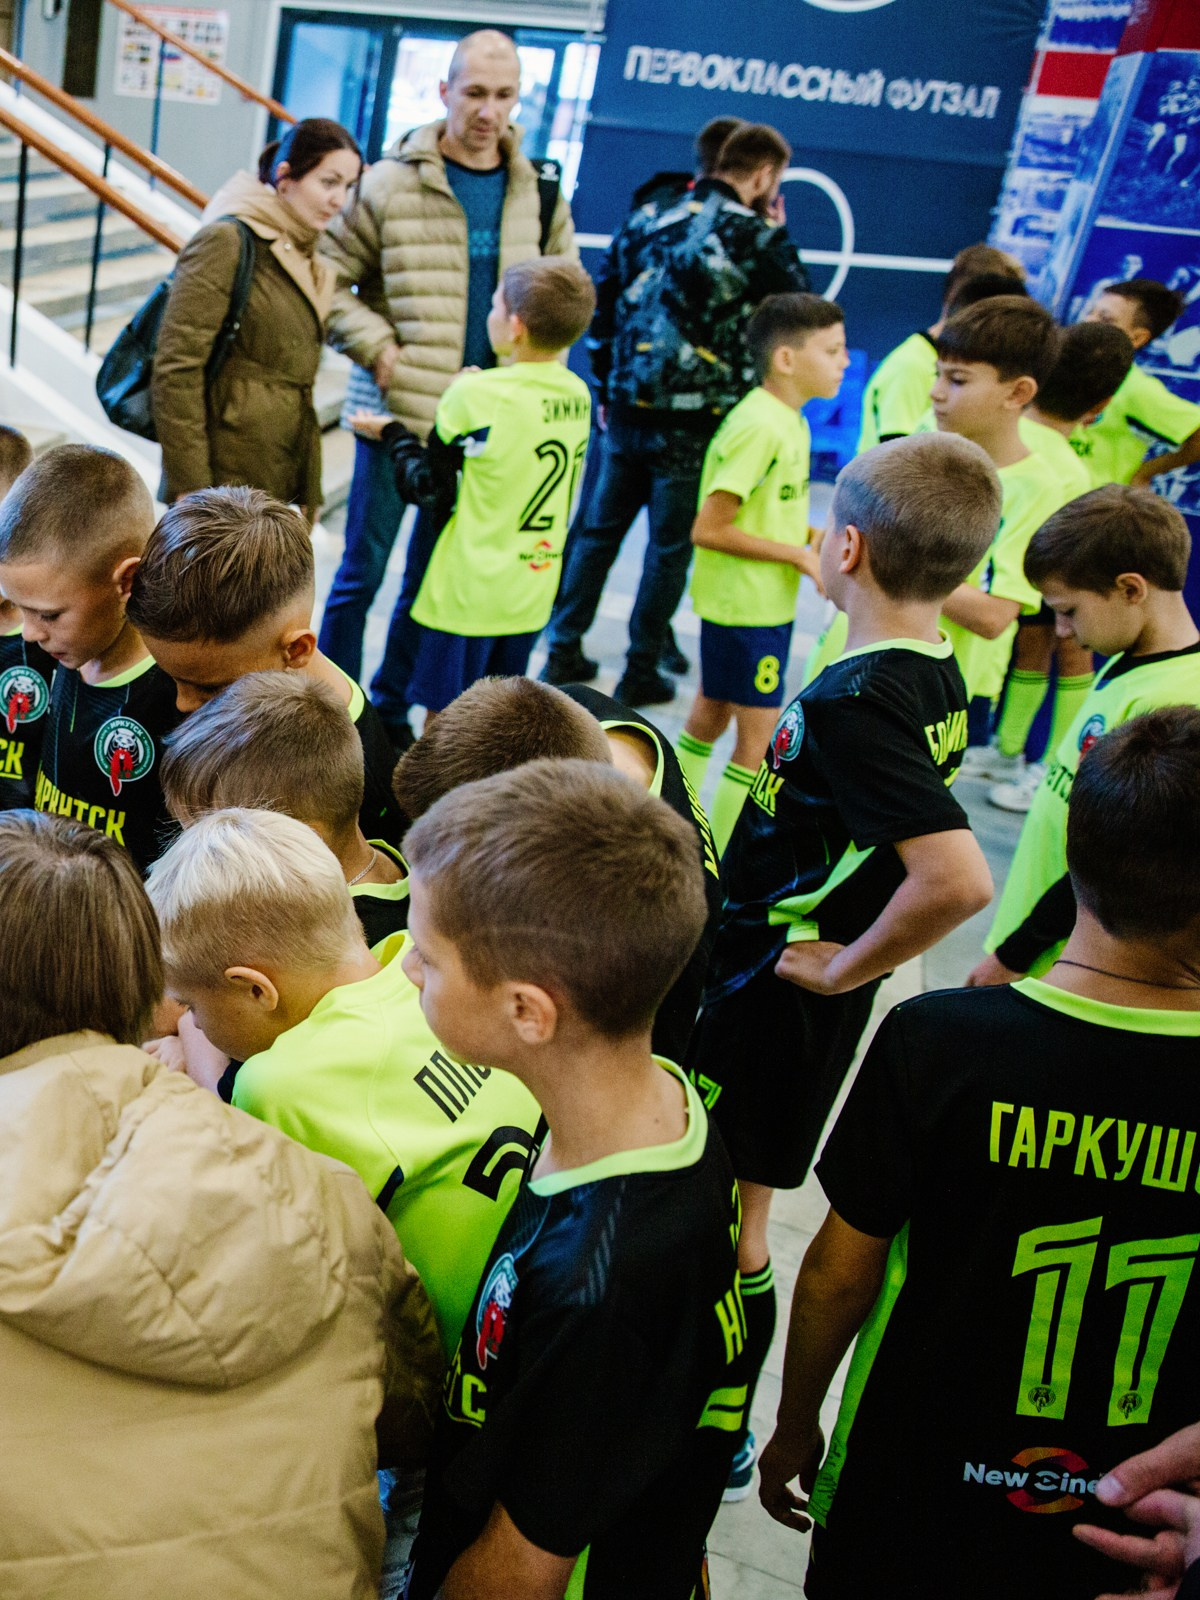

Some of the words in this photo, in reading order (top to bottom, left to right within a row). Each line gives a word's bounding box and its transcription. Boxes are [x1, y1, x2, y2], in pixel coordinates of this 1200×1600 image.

[623, 45, 886, 107] ПЕРВОКЛАССНЫЙ
[885, 76, 1002, 119] ФУТЗАЛ
[754, 655, 780, 694] 8
[109, 720, 144, 738] ИРКУТСК
[990, 1101, 1200, 1193] ГАРКУШ
[1011, 1216, 1200, 1427] 11
[963, 1461, 1029, 1488] New
